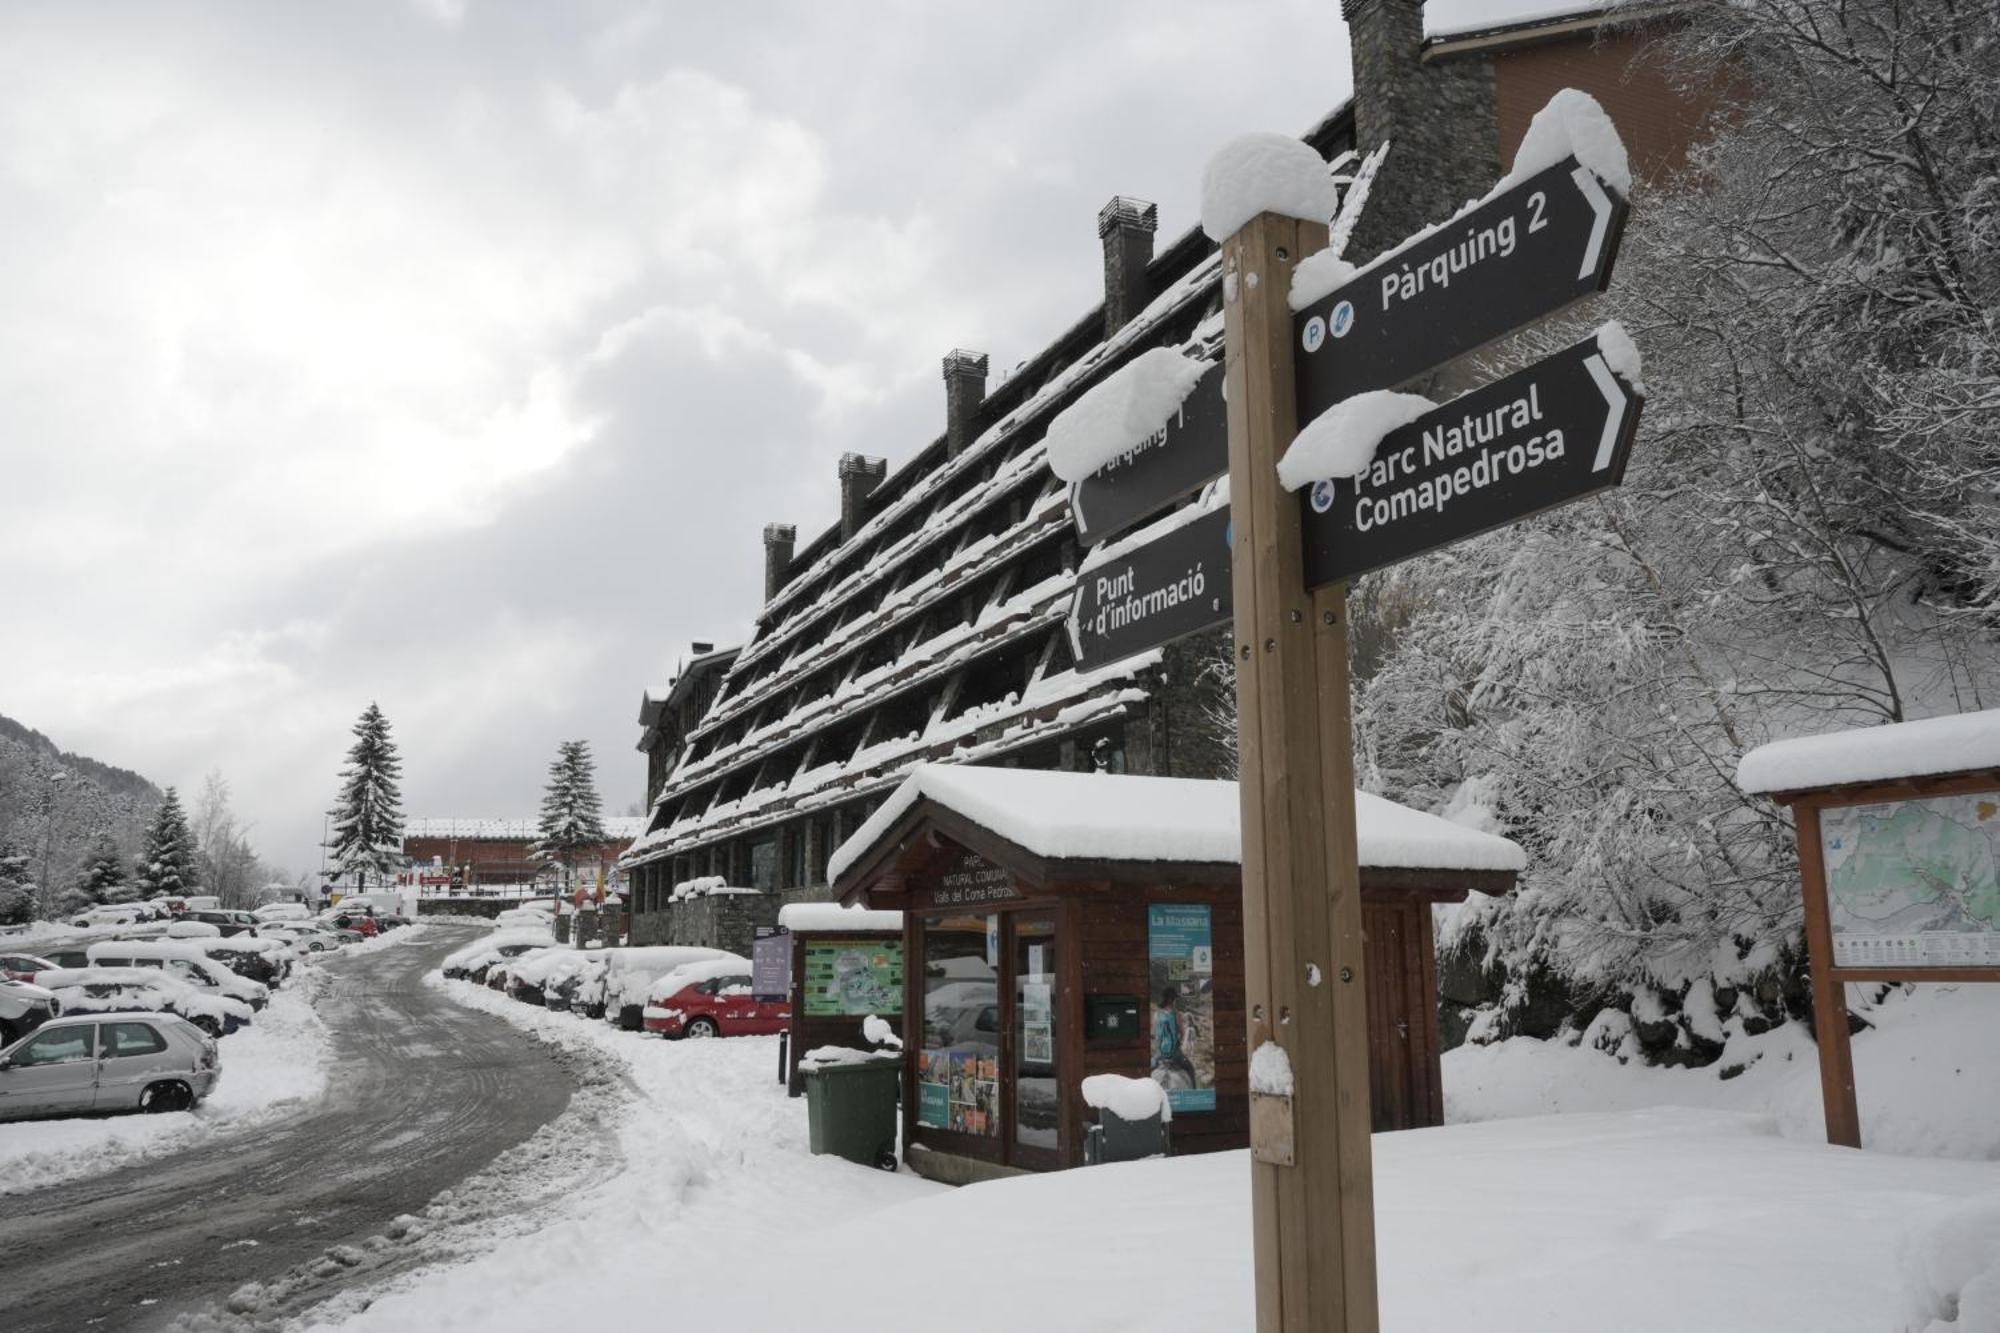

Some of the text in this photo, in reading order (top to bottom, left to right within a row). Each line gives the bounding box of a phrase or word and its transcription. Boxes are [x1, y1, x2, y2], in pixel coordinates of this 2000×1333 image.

[1382, 191, 1548, 311] Pàrquing 2
[1354, 383, 1543, 495] Parc Natural
[1355, 429, 1565, 532] Comapedrosa
[1096, 566, 1134, 606] Punt
[1096, 562, 1205, 635] d'informació
